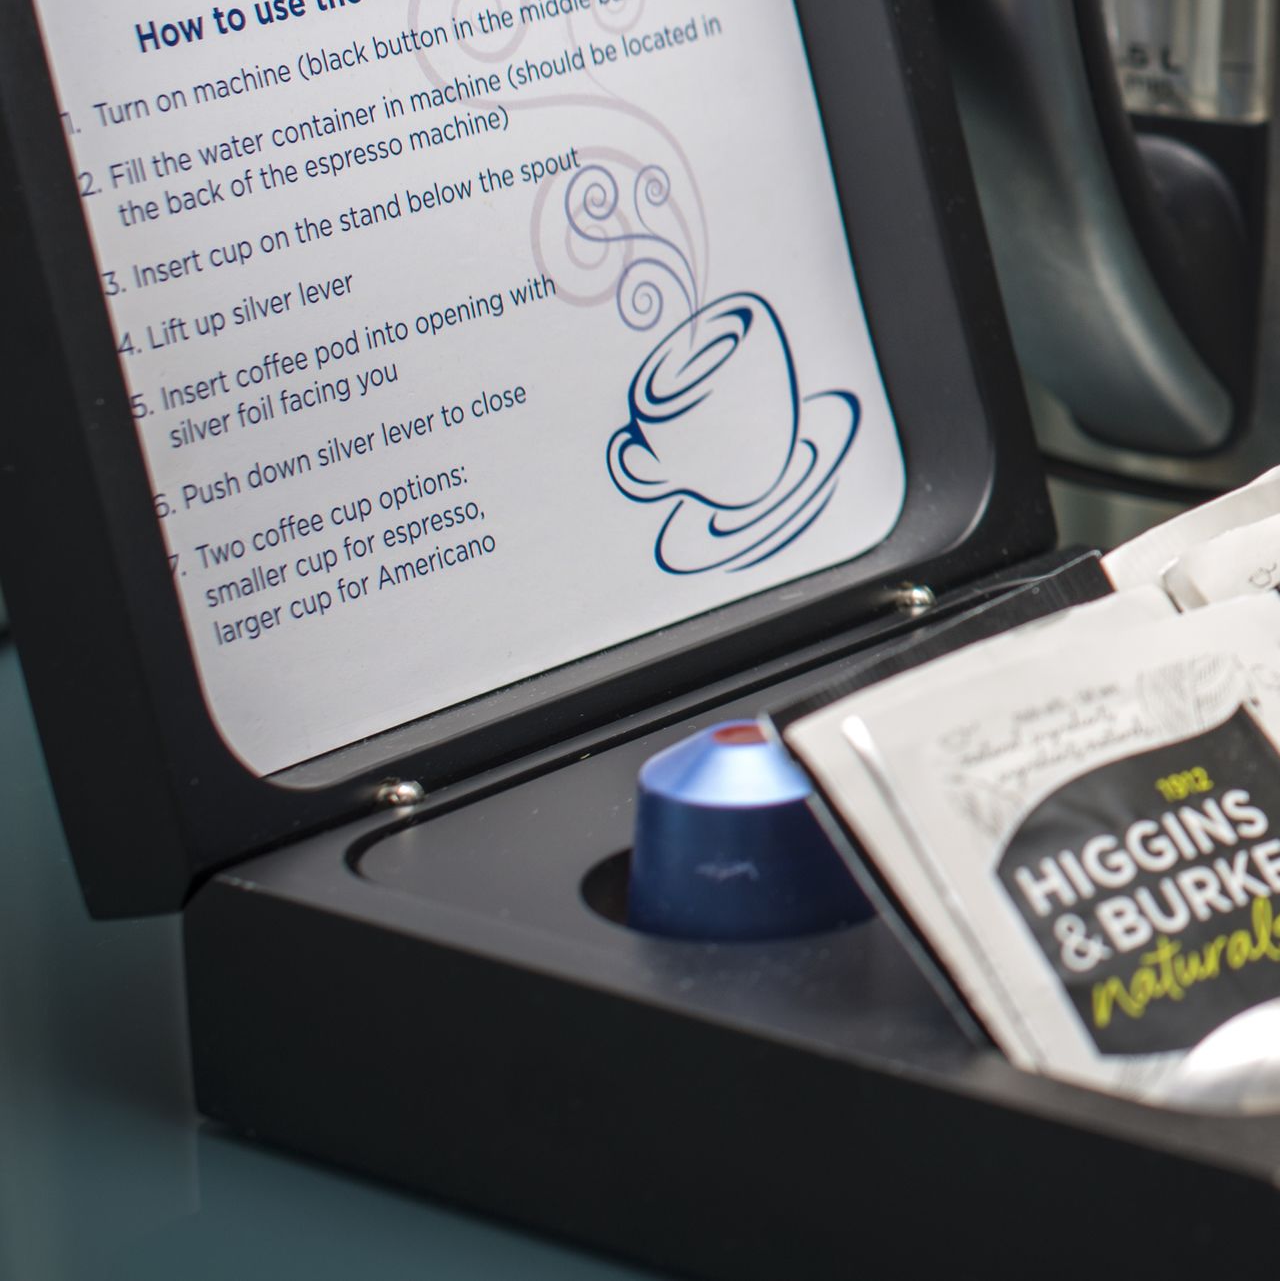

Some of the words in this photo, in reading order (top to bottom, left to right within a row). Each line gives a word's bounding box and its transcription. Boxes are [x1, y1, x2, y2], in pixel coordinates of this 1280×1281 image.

[92, 99, 151, 127] Turn
[156, 89, 188, 113] on
[193, 63, 292, 105] machine
[297, 40, 370, 82] (black
[372, 23, 448, 61] button
[451, 17, 475, 41] in
[477, 7, 514, 35] the
[135, 15, 204, 53] How
[213, 7, 247, 35] to
[78, 171, 103, 197] 2.
[109, 157, 148, 189] Fill
[152, 150, 193, 178] the
[198, 132, 264, 168] water
[271, 103, 377, 148] container
[382, 95, 405, 119] in
[409, 69, 502, 113] machine
[507, 46, 586, 90] (should
[589, 41, 618, 67] be
[620, 18, 699, 59] located
[701, 13, 723, 38] in
[101, 271, 127, 296] 3.
[133, 249, 203, 289] Insert
[208, 238, 253, 267] cup
[260, 230, 291, 253] on
[295, 216, 334, 245] the
[339, 192, 402, 233] stand
[405, 177, 473, 215] below
[478, 168, 515, 194] the
[519, 147, 581, 185] spout
[118, 198, 160, 228] the
[164, 180, 225, 215] back
[230, 170, 254, 199] of
[260, 164, 299, 192] the
[304, 137, 403, 178] espresso
[408, 104, 510, 152] machine)
[116, 331, 143, 356] 4.
[146, 317, 191, 352] Lift
[195, 311, 226, 337] up
[232, 289, 293, 327] silver
[298, 272, 354, 307] lever
[130, 393, 155, 419] 5.
[159, 371, 231, 411] Insert
[235, 349, 309, 389] coffee
[314, 330, 360, 370] pod
[364, 319, 409, 351] into
[415, 292, 504, 337] opening
[509, 273, 557, 307] with
[169, 412, 232, 449] silver
[238, 394, 275, 429] foil
[279, 374, 351, 416] facing
[356, 362, 400, 398] you
[181, 471, 242, 510] Push
[246, 449, 313, 490] down
[317, 431, 376, 468] silver
[380, 409, 435, 447] lever
[440, 401, 466, 427] to
[470, 383, 528, 419] close
[194, 539, 246, 569] Two
[251, 513, 325, 552] coffee
[330, 495, 373, 527] cup
[378, 464, 469, 511] options:
[205, 571, 289, 609] smaller
[294, 547, 339, 577] cup
[343, 535, 376, 563] for
[382, 499, 487, 550] espresso,
[212, 604, 283, 647] larger
[289, 588, 333, 620] cup
[336, 574, 371, 604] for
[377, 531, 498, 591] Americano
[1155, 766, 1216, 802] 1912
[1013, 789, 1270, 918] HIGGINS
